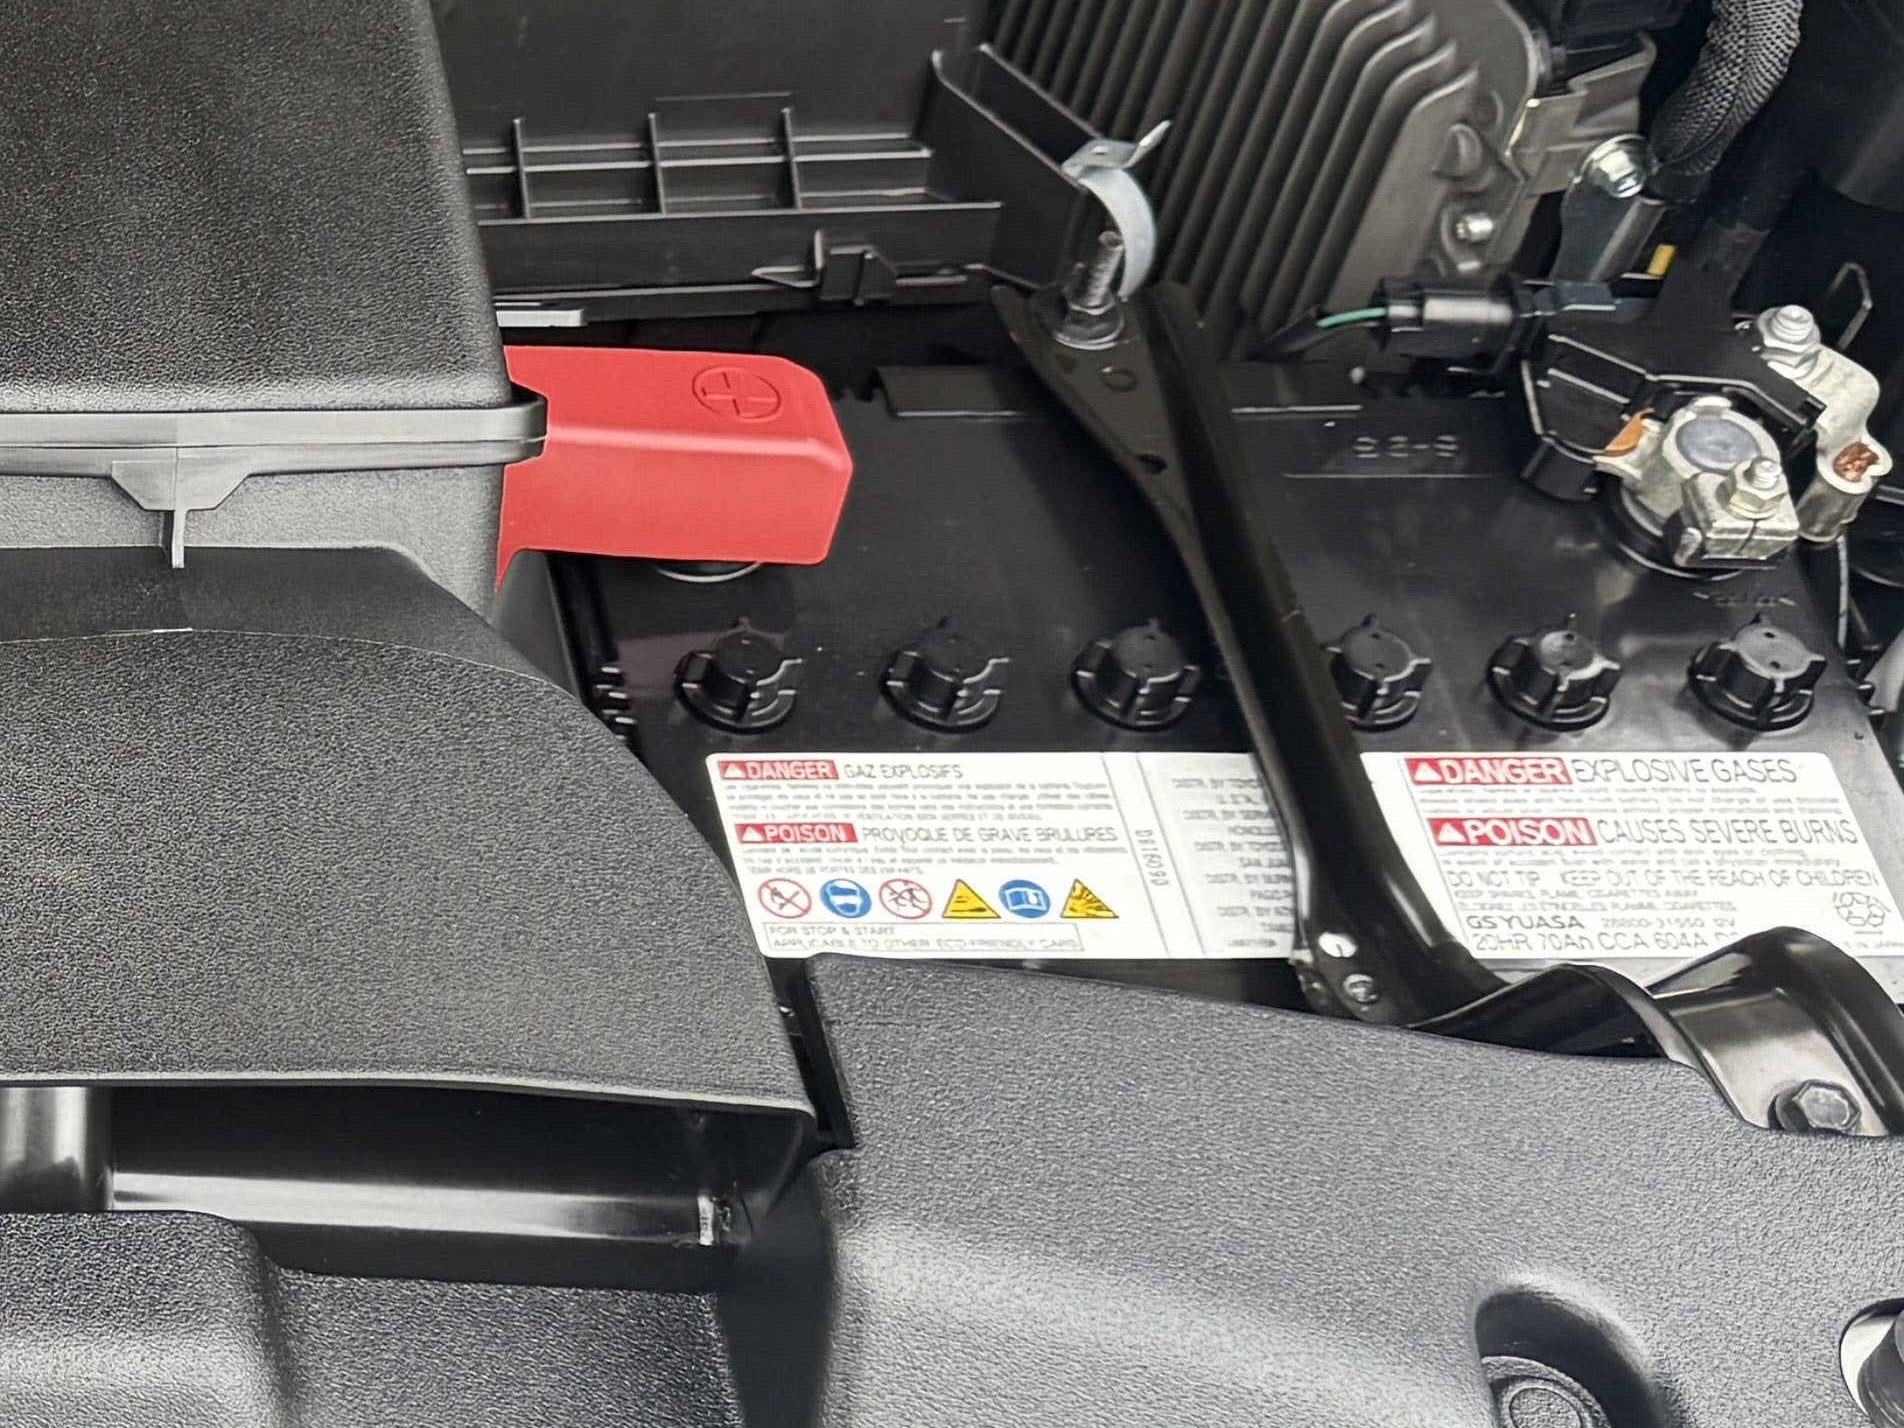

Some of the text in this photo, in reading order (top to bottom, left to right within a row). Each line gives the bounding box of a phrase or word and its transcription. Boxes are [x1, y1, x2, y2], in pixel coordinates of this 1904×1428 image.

[746, 761, 835, 780] DANGER
[843, 763, 964, 779] GAZ EXPLOSIFS
[1440, 758, 1569, 783] DANGER
[1571, 758, 1798, 783] EXPLOSIVE GASES
[763, 824, 848, 843] POISON
[862, 826, 950, 843] PROVOQUE
[952, 826, 975, 842] DE
[978, 826, 1033, 842] GRAVE
[1461, 818, 1594, 845] POISON
[1597, 818, 1859, 844] CAUSES SEVERE BURNS
[1447, 870, 1473, 887] DO
[1476, 870, 1510, 887] NOT
[1605, 870, 1636, 887] OUT
[1644, 870, 1666, 887] OF
[1670, 870, 1705, 887] THE
[1708, 869, 1767, 887] REACH
[1768, 869, 1791, 887] OF
[1596, 931, 1651, 951] CCA
